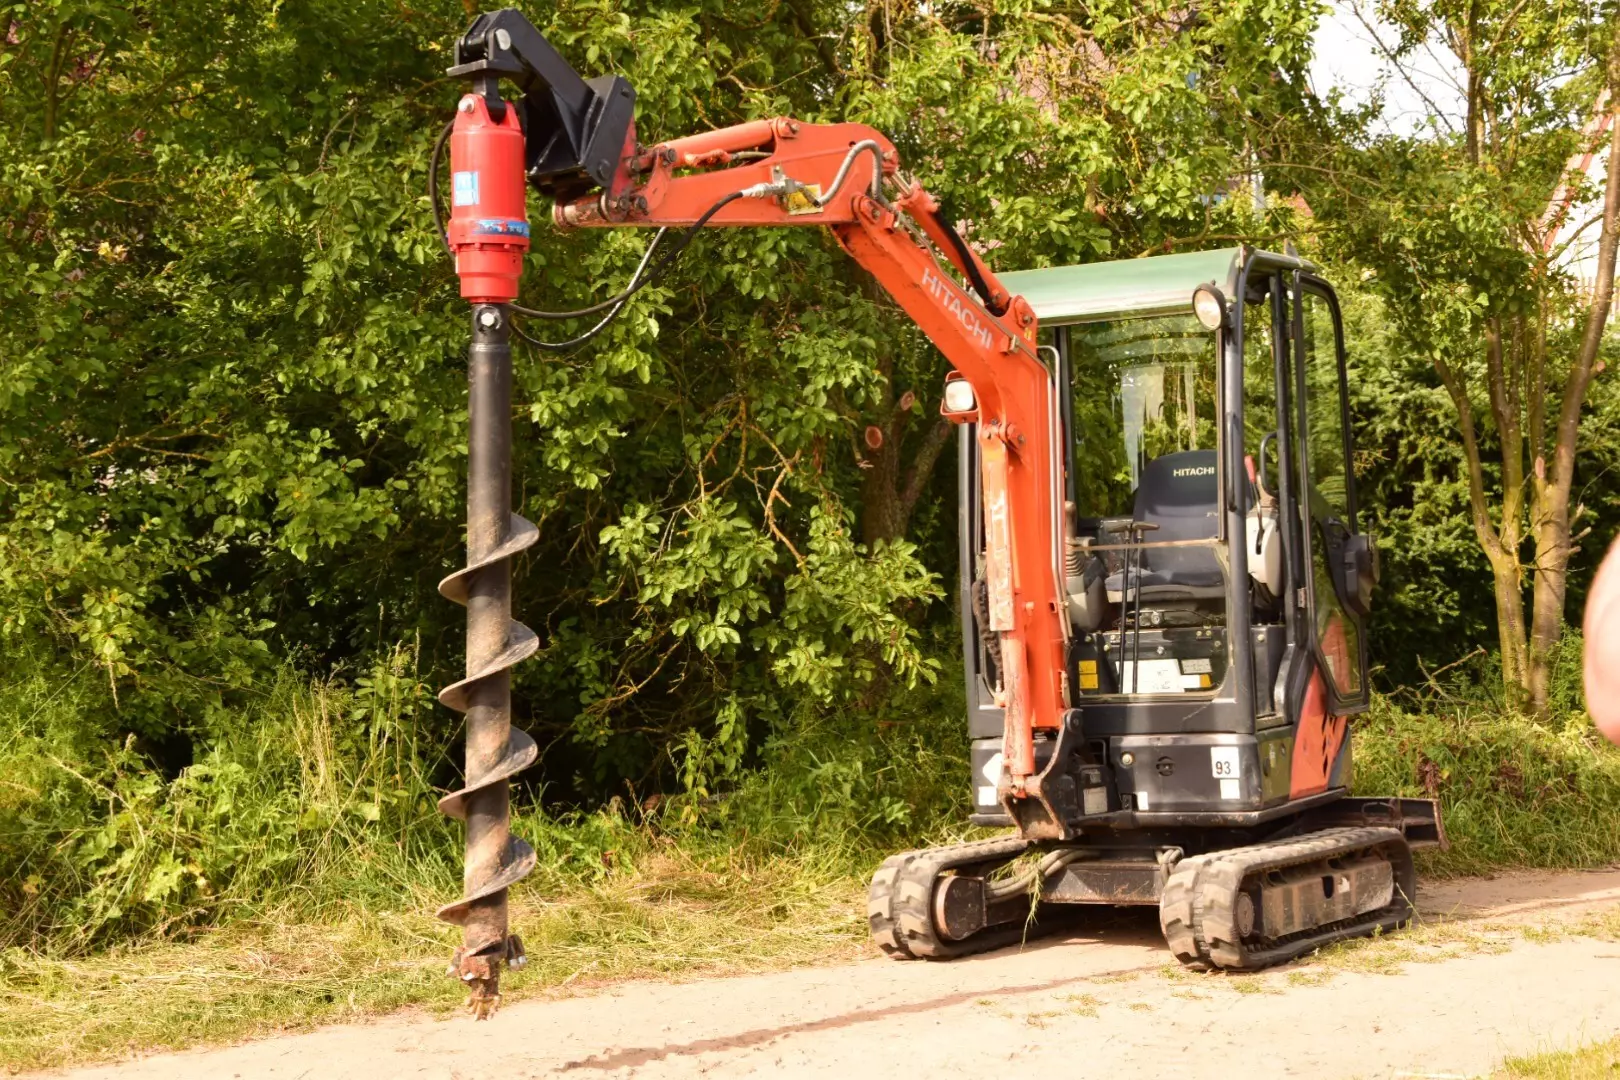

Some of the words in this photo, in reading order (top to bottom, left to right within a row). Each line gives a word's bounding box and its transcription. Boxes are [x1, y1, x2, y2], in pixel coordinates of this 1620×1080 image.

[921, 267, 994, 350] HITACHI
[1173, 466, 1215, 477] HITACHI
[1215, 760, 1231, 775] 93
